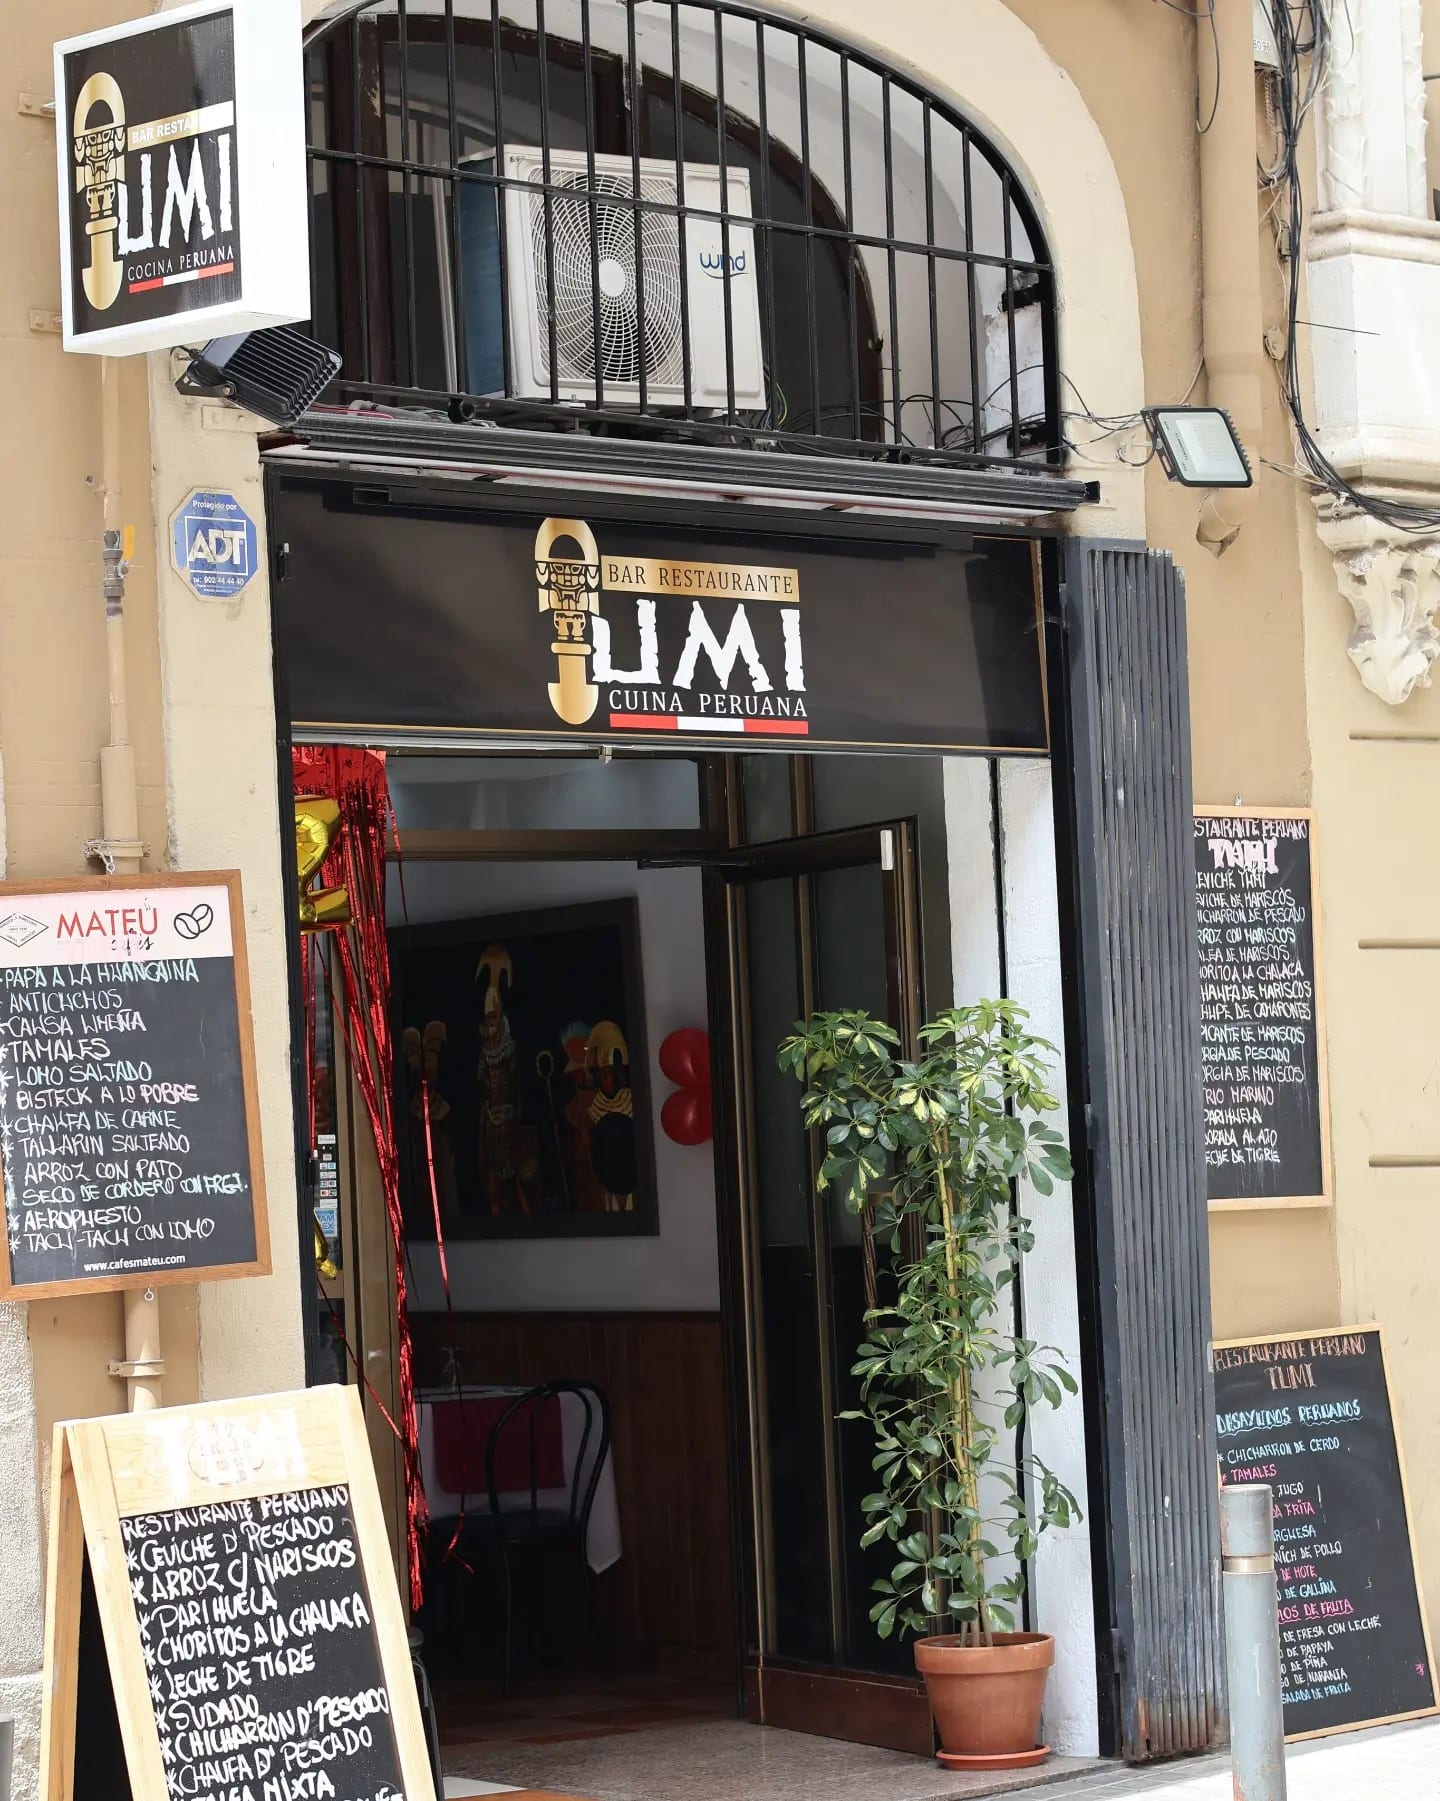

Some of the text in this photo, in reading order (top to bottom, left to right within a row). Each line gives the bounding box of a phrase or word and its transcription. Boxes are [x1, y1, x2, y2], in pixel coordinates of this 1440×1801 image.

[131, 127, 154, 144] BAR
[127, 245, 234, 281] COCINA PERUANA
[225, 503, 237, 511] por
[188, 529, 246, 565] ADT
[204, 575, 217, 584] 902
[608, 563, 793, 594] BAR RESTAURANTE
[609, 689, 808, 717] CUINA PERUANA
[1193, 818, 1260, 838] STAURANTE
[1195, 869, 1236, 890] EVICHE
[1230, 892, 1244, 909] DE
[1244, 887, 1296, 908] MARISCOS
[57, 907, 158, 938] MATEU
[1248, 908, 1263, 923] DE
[1264, 906, 1306, 924] PESCADO
[1197, 927, 1297, 944] RROZ CON MARISCOS
[1225, 944, 1290, 963] DE MARISCOS
[5, 958, 200, 989] PAPA A LA HUANCAINA
[1232, 960, 1304, 983] A LA CHALACA
[10, 988, 122, 1014] ANTICUCHOS
[1242, 984, 1258, 1000] DE
[1258, 980, 1312, 1000] MARISCOS
[1200, 1003, 1233, 1020] HUPE
[1234, 1002, 1252, 1020] DE
[8, 1014, 73, 1037] CAUSA
[1240, 1024, 1305, 1044] DE MARISCOS
[7, 1037, 111, 1063] TAMALES
[1227, 1046, 1242, 1061] DE
[1244, 1045, 1289, 1063] PESCADO
[15, 1060, 152, 1087] LOMO SALTADO
[1235, 1066, 1252, 1082] DE
[1252, 1064, 1304, 1083] MARISCOS
[16, 1082, 200, 1110] BISTECK A LO POBRE
[95, 1109, 119, 1130] DE
[121, 1109, 181, 1130] CARNE
[18, 1131, 190, 1158] TALLARIN SALTEADO
[1243, 1128, 1256, 1145] AL
[1205, 1147, 1281, 1166] ECHE DE TIGRE
[25, 1159, 183, 1187] ARROZ CON PATO
[22, 1185, 75, 1206] SECO
[80, 1184, 100, 1202] DE
[105, 1178, 174, 1199] CORDERO
[180, 1174, 203, 1193] CON
[24, 1205, 141, 1232] AEROPUESTO
[135, 1222, 164, 1241] CON
[168, 1217, 215, 1241] LOMO
[84, 1255, 186, 1272] www.cafesmateu.com
[1213, 1334, 1366, 1372] RESTAURANTE PERUANO
[1264, 1362, 1318, 1391] TUMI
[1216, 1398, 1362, 1434] DESAYUNOS PERUANOS
[1227, 1436, 1340, 1464] CHICHARRON DE CERDO
[1230, 1463, 1277, 1482] TAMALES
[1276, 1481, 1304, 1498] JUGO
[119, 1485, 349, 1541] RESTAURANTE PERUANO
[140, 1532, 217, 1572] CEVICHE
[240, 1515, 334, 1550] PESCADO
[1300, 1540, 1342, 1559] DE POLLO
[151, 1562, 224, 1600] ARROZ
[1280, 1567, 1292, 1582] DE
[1285, 1586, 1297, 1599] DE
[1299, 1577, 1337, 1598] GALLINA
[1303, 1602, 1318, 1616] DE
[1320, 1598, 1354, 1615] FRUTA
[157, 1625, 250, 1666] CHORITOS
[254, 1620, 268, 1648] A
[288, 1591, 371, 1637] CHALACA
[1283, 1630, 1296, 1643] DE
[1296, 1625, 1325, 1641] FRESA
[1327, 1622, 1346, 1636] CON
[1347, 1614, 1382, 1632] LECHE
[1286, 1646, 1298, 1658] DE
[1300, 1640, 1334, 1656] PAPAYA
[165, 1642, 316, 1700] LECHE DE TIGRE
[1290, 1660, 1303, 1673] DE
[1302, 1654, 1328, 1670] PIÑA
[1293, 1674, 1305, 1685] DE
[1307, 1667, 1348, 1683] NARANJA
[1311, 1687, 1324, 1700] DE
[1324, 1681, 1352, 1697] FRUTA
[168, 1693, 259, 1731] SUDADO
[175, 1708, 296, 1763] CHICHARRON
[313, 1686, 390, 1733] PESCADO
[178, 1753, 254, 1794] CHAUFA
[279, 1725, 373, 1773] PESCADO
